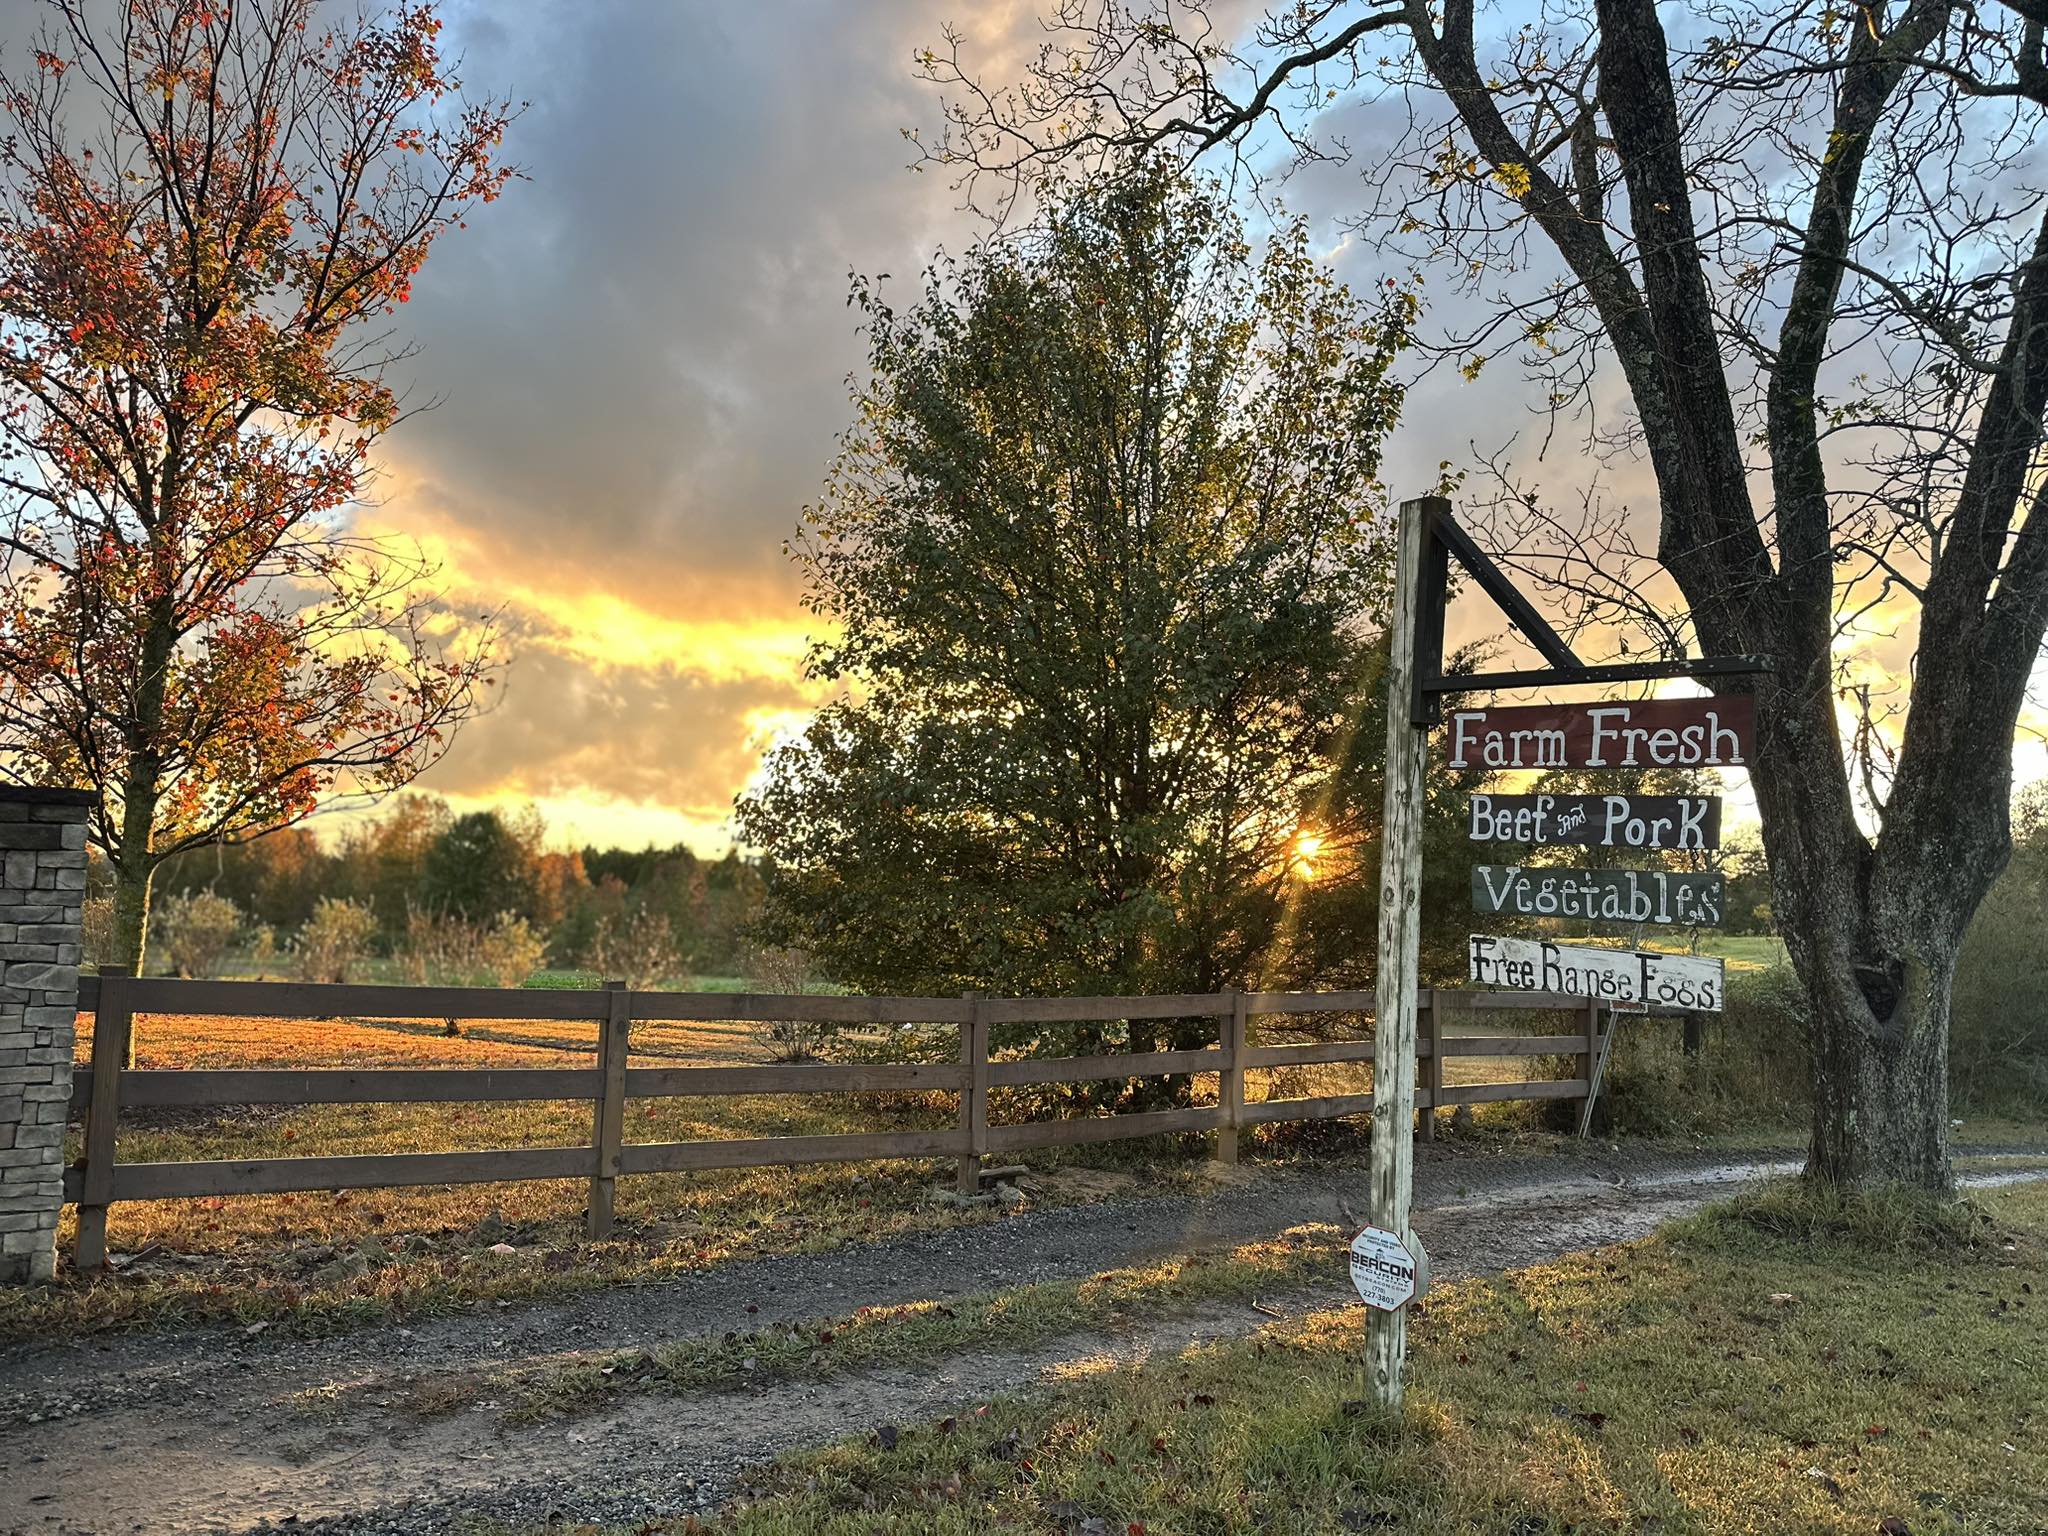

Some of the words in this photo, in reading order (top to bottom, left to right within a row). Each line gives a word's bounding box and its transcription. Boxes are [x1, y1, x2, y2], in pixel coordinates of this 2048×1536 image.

[1449, 712, 1568, 768] Farm
[1585, 706, 1745, 766] Fresh
[1469, 795, 1554, 844] Beef
[1477, 866, 1719, 926] Vegetables
[1471, 937, 1535, 989] Free
[1540, 942, 1634, 1000] Range
[1635, 953, 1715, 1009] Eggs
[1351, 1251, 1413, 1280] BEACON
[1352, 1263, 1410, 1284] SECURITY
[1363, 1290, 1395, 1305] 227-3803
[1372, 1285, 1386, 1294] (770)
